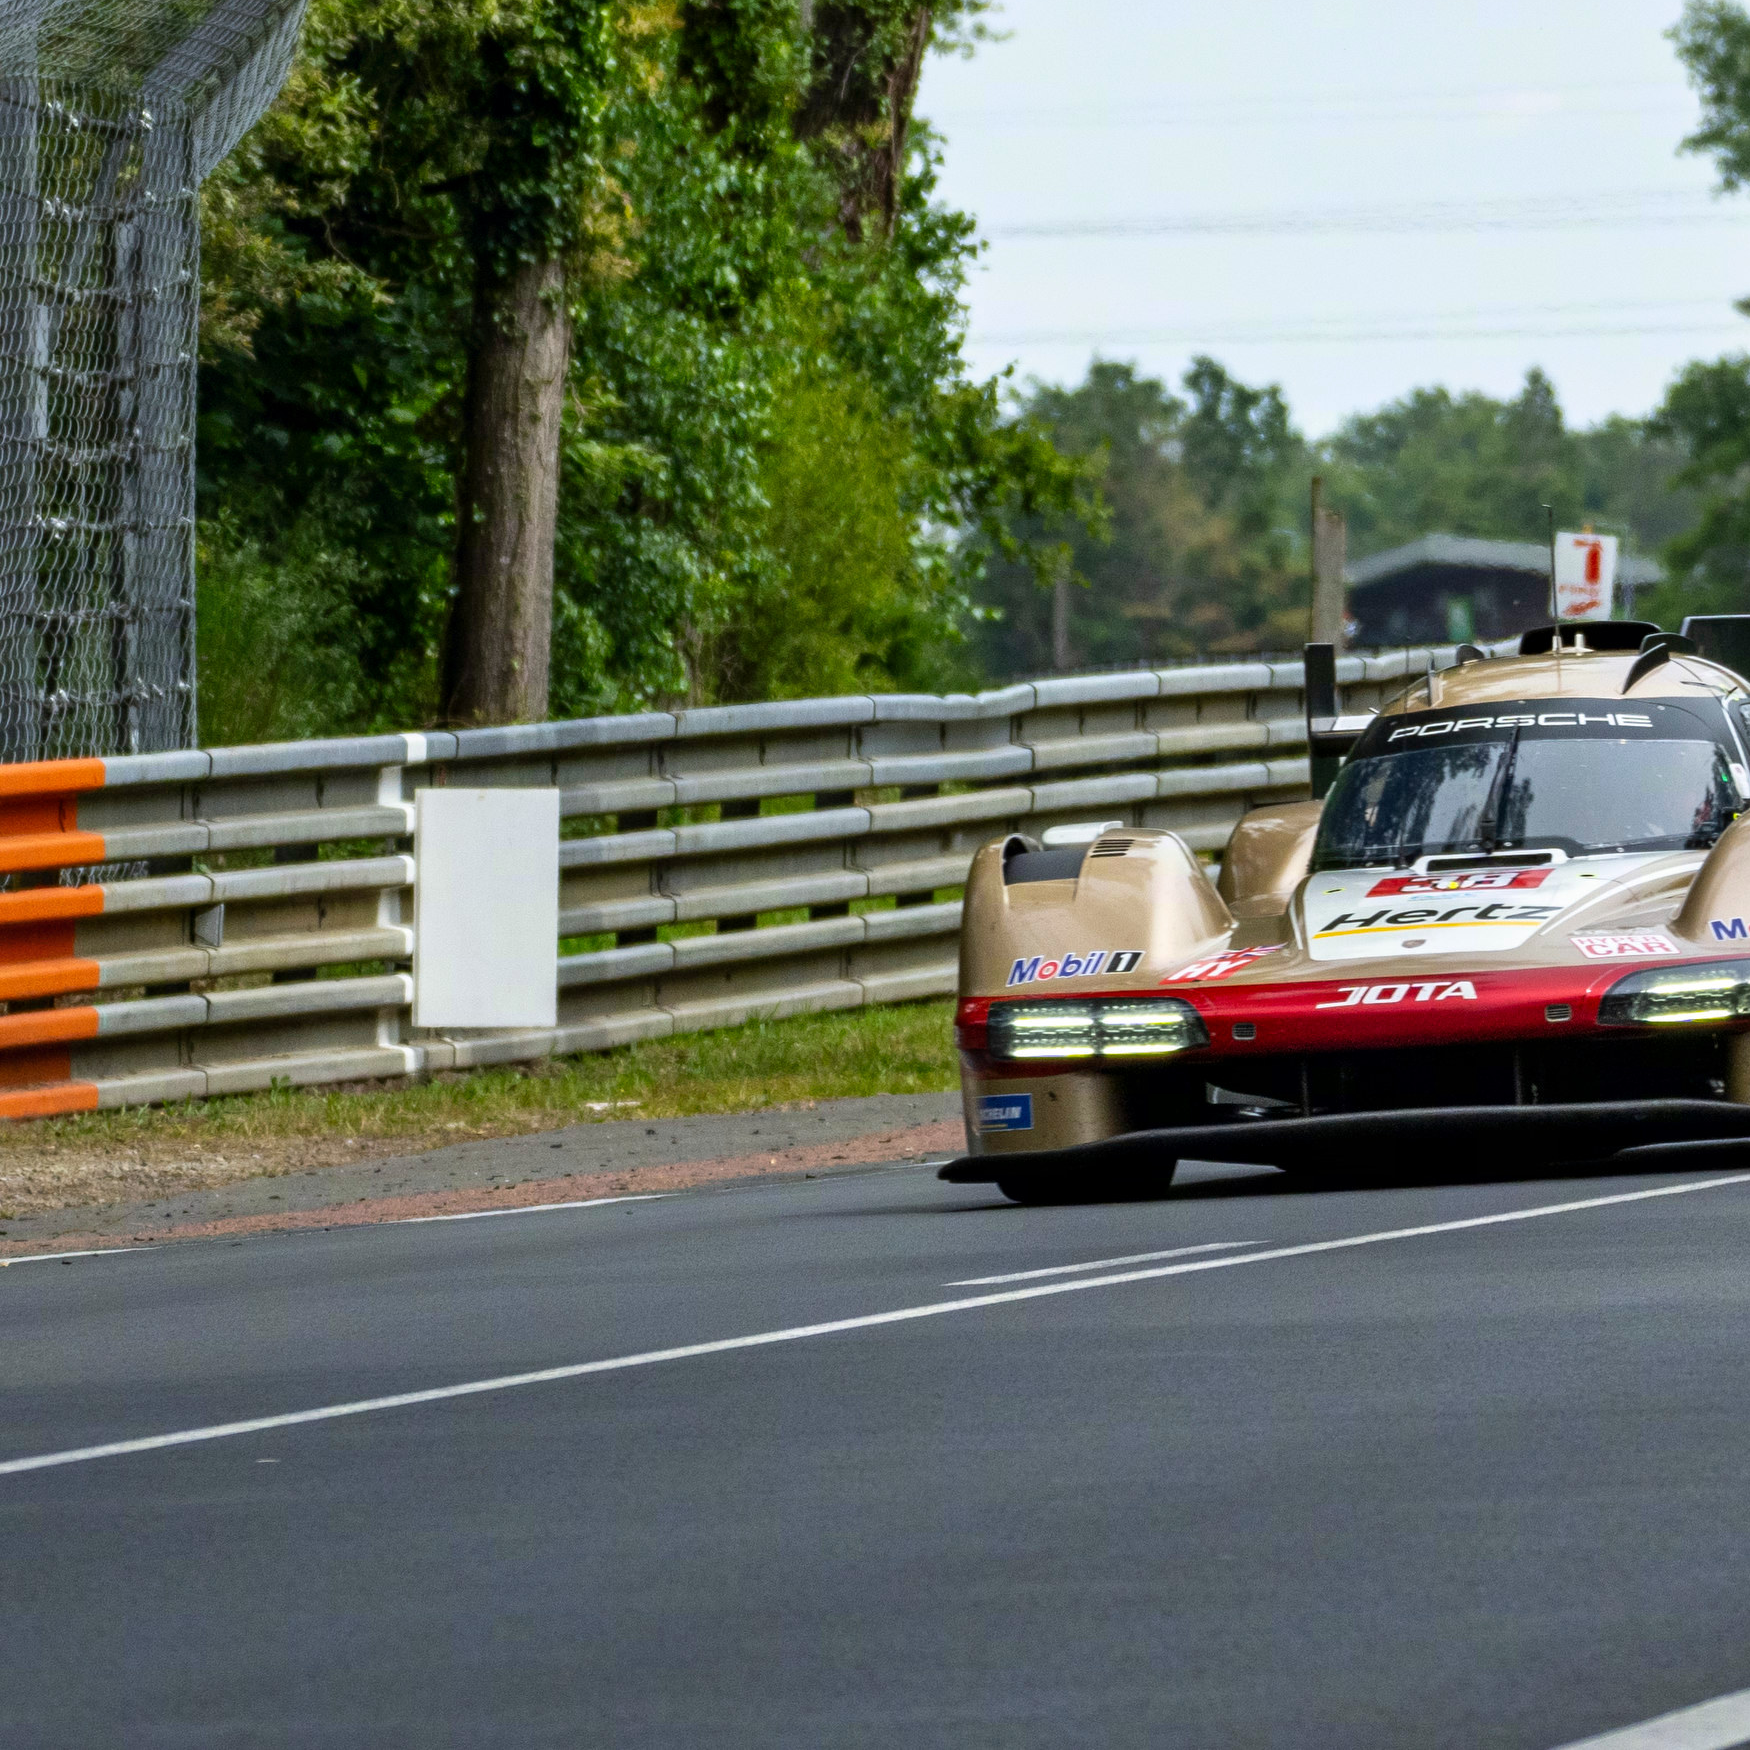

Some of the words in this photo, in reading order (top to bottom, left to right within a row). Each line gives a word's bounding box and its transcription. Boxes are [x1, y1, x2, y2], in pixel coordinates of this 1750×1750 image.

[1387, 712, 1654, 743] PORSCHE
[1319, 903, 1564, 933] Hertz
[1585, 942, 1673, 957] CAR
[1006, 950, 1107, 987] Mobil
[1315, 980, 1478, 1010] JOTA
